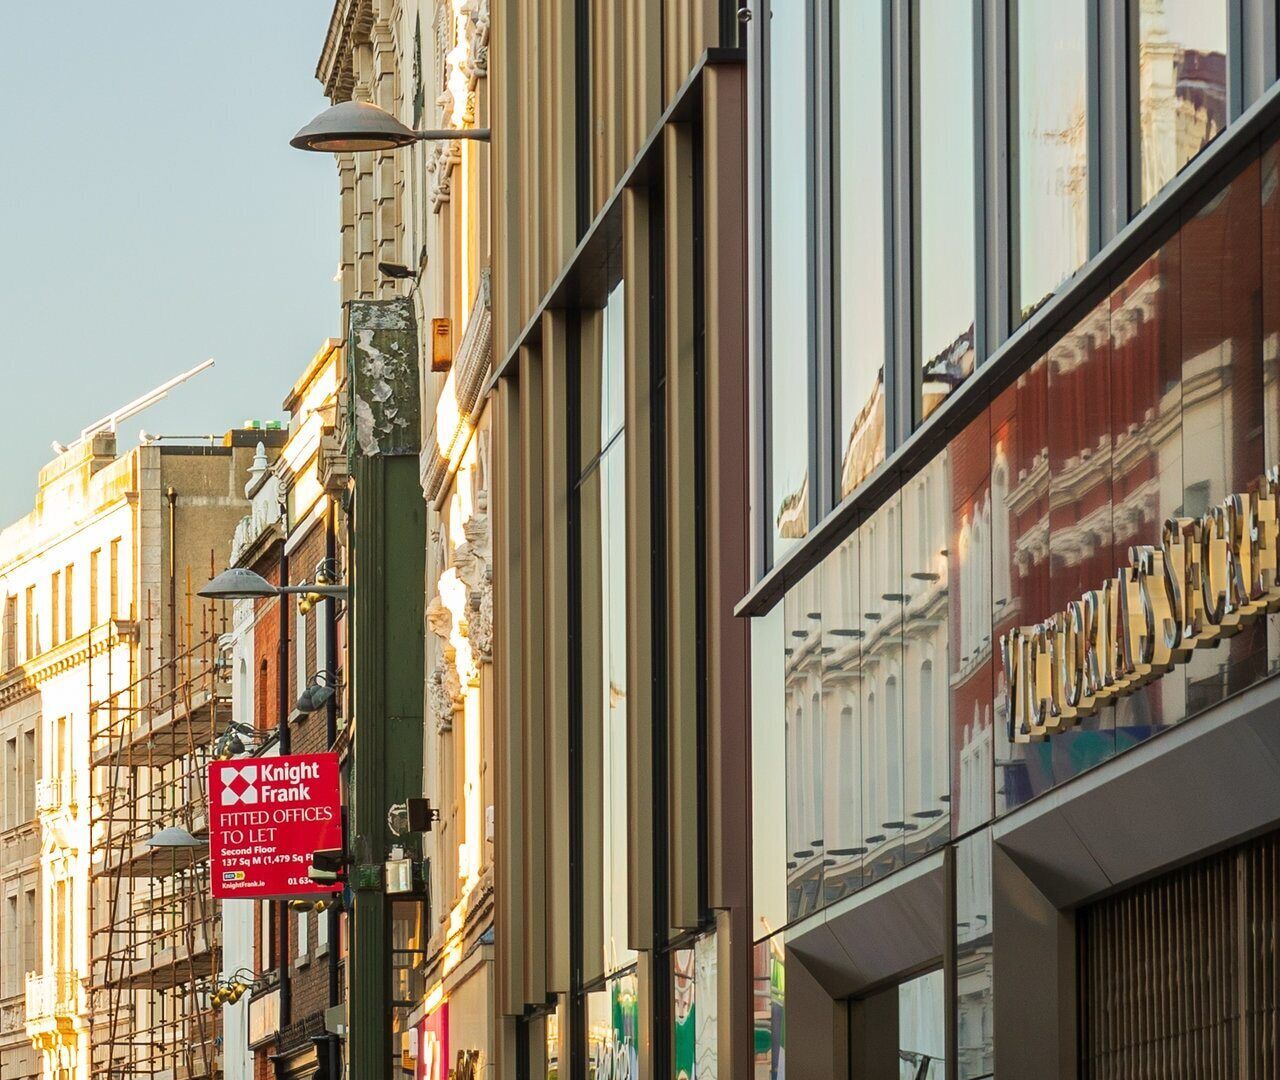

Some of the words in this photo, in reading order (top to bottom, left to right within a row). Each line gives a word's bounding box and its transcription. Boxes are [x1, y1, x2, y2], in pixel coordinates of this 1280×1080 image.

[261, 761, 320, 784] Knight
[261, 784, 311, 803] Frank
[220, 810, 270, 827] FITTED
[273, 806, 333, 823] OFFICES
[220, 830, 244, 845] TO
[249, 827, 277, 843] LET
[221, 846, 252, 856] Second
[254, 845, 276, 854] Floor
[222, 858, 237, 867] 137
[239, 857, 251, 867] Sq
[252, 856, 261, 865] M
[292, 854, 304, 864] Sq
[222, 881, 265, 890] KnightFrank.ie
